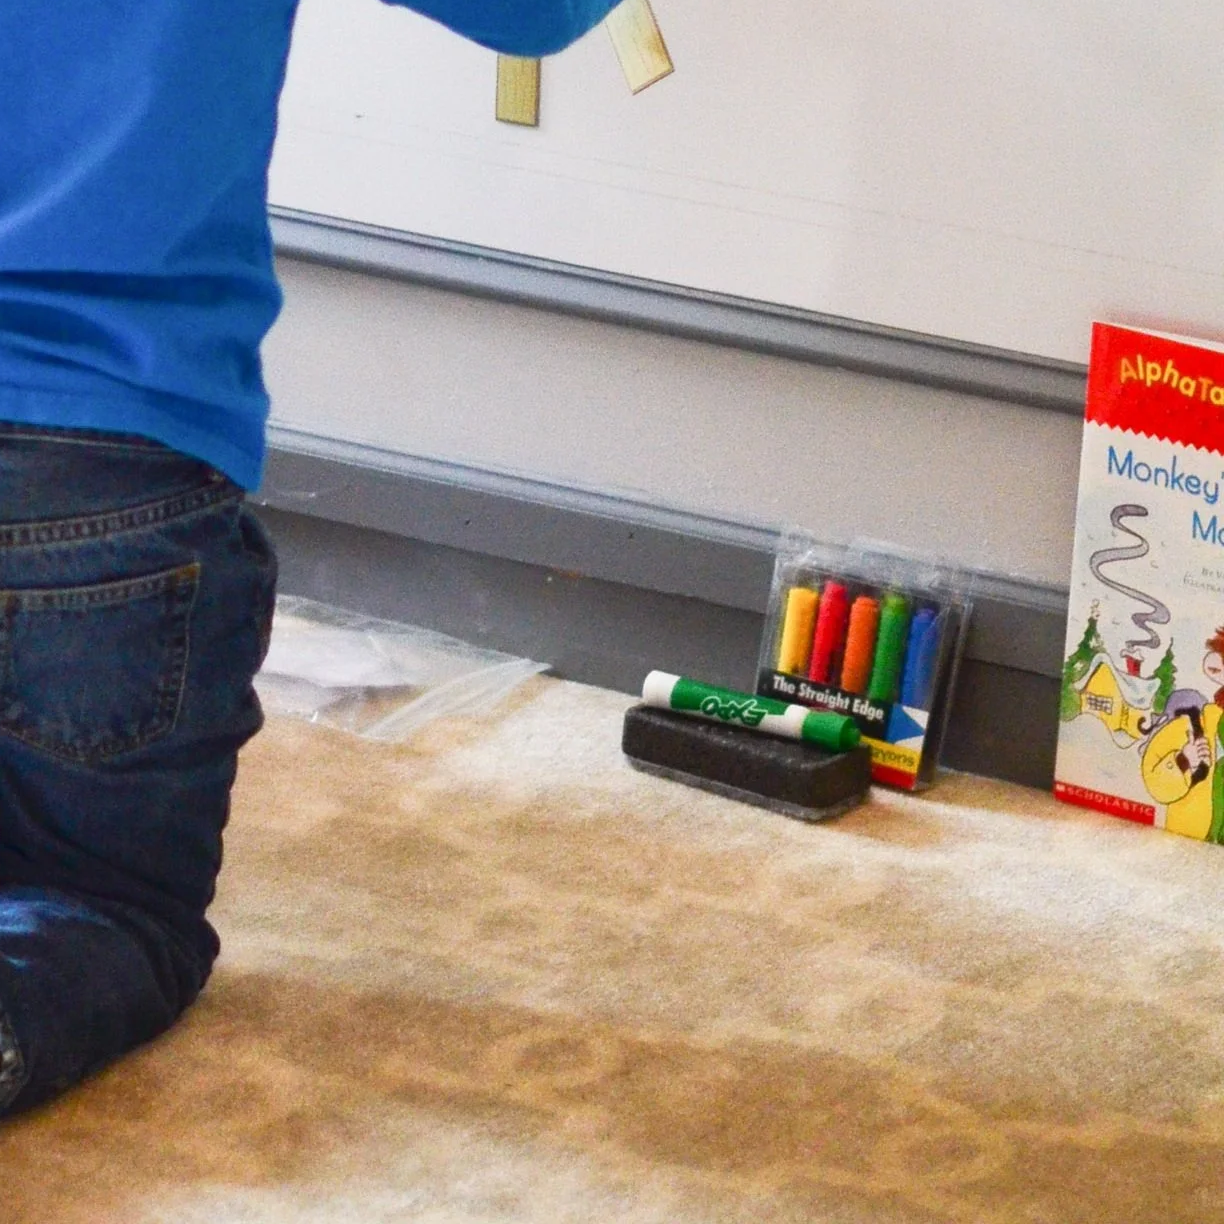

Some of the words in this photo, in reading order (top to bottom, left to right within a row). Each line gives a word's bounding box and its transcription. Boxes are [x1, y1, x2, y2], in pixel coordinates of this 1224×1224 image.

[773, 675, 796, 695] The
[799, 682, 850, 710] Straight
[852, 698, 885, 721] Edge
[871, 748, 915, 768] ayons
[1067, 786, 1154, 817] SCHOLASTIC
